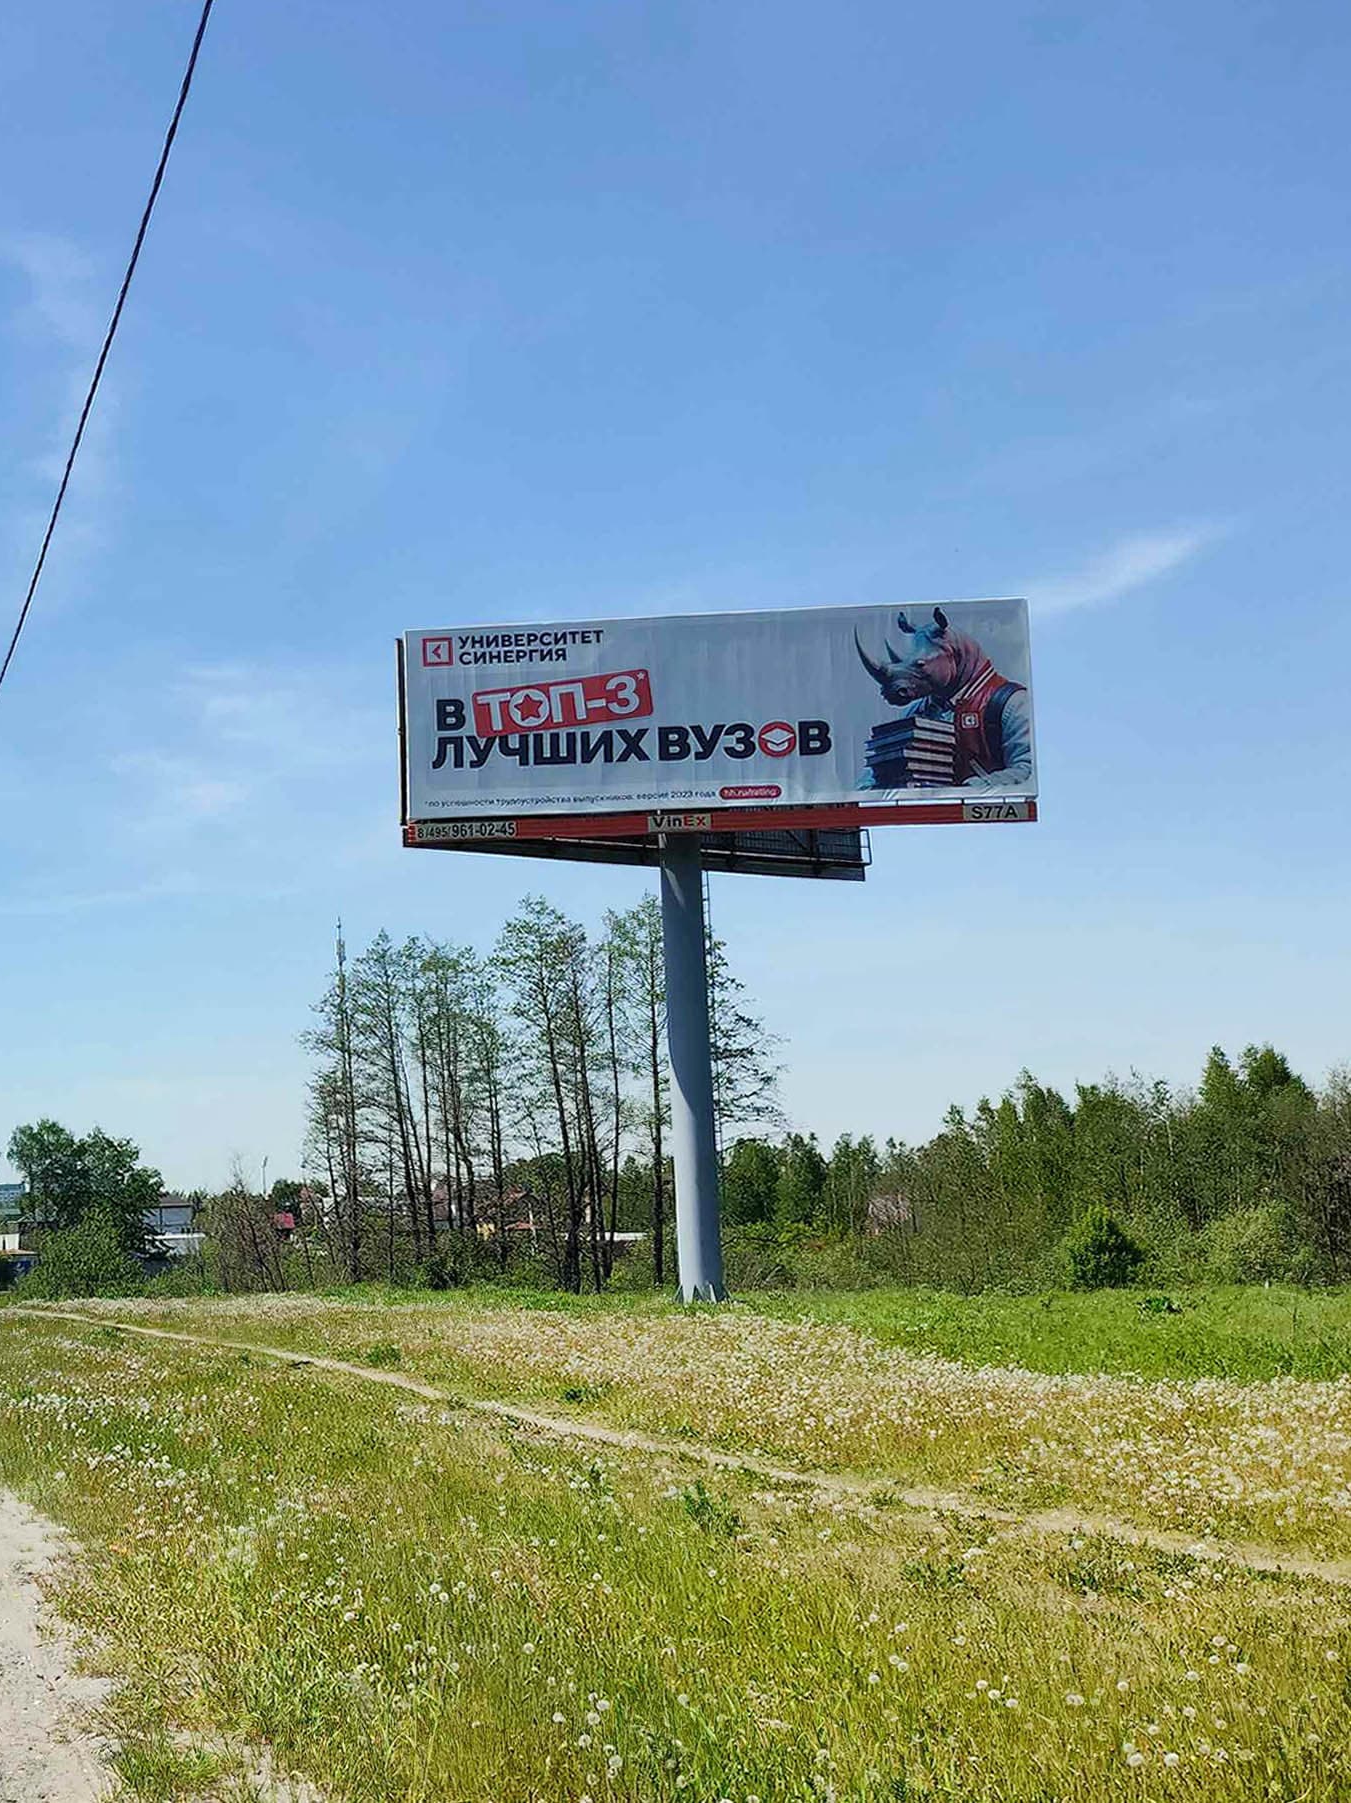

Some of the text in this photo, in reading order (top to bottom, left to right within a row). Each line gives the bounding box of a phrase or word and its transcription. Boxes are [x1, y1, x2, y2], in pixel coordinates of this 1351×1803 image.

[458, 629, 605, 650] УНИВЕРСИТЕТ
[458, 647, 568, 666] СИНЕРГИЯ
[436, 699, 466, 731] В
[432, 720, 832, 769] ЛУЧШИХ ВУЗОВ
[670, 790, 693, 800] 2023
[694, 790, 717, 799] года
[971, 804, 1018, 819] S77A
